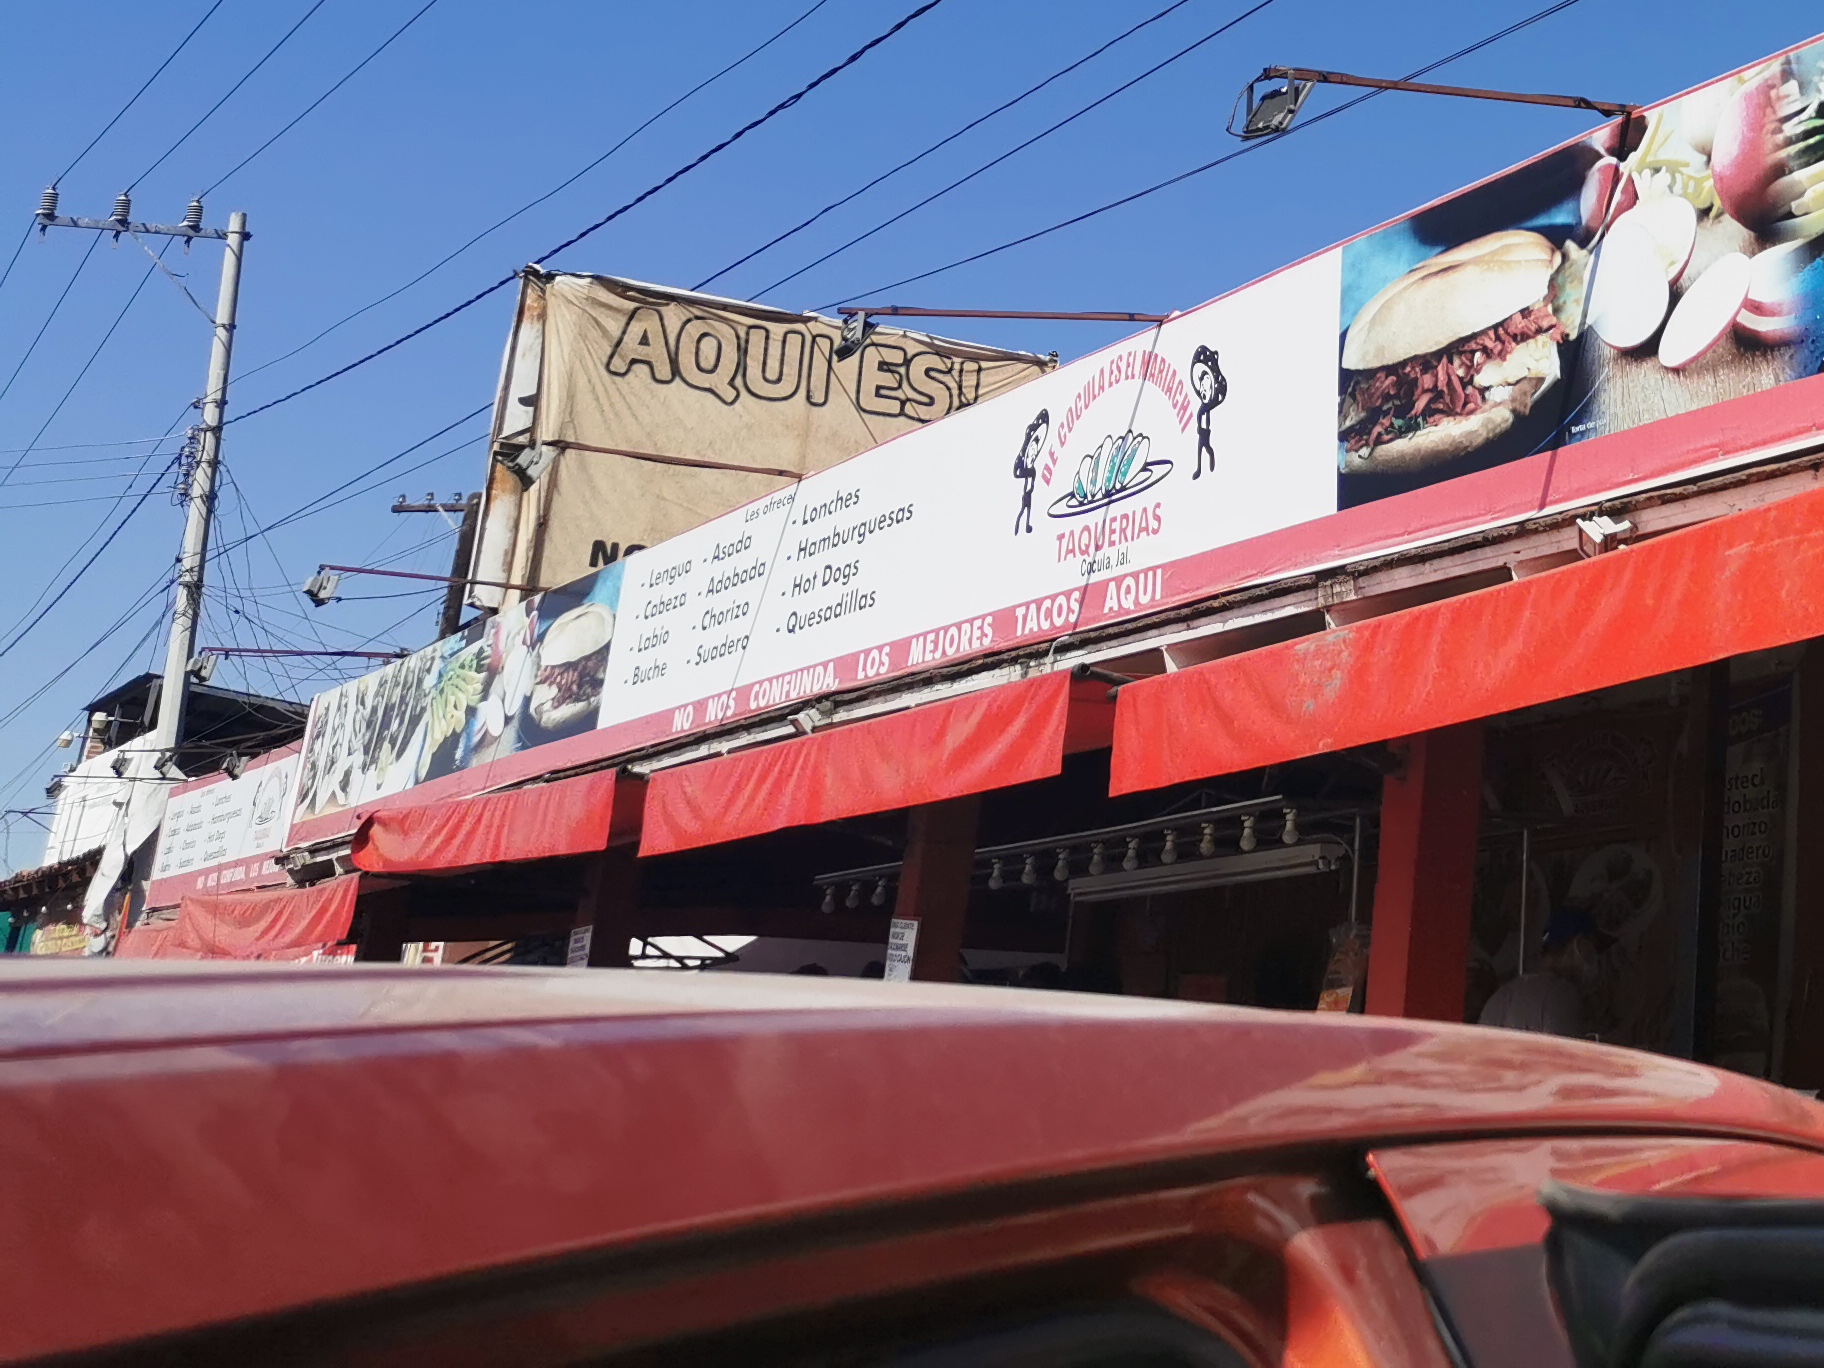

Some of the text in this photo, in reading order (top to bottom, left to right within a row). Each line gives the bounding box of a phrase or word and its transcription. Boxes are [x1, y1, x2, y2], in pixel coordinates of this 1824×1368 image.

[606, 306, 834, 407] AQUI
[1040, 349, 1194, 487] DE COCULA ES EL MARIACHI
[802, 488, 860, 527] Lonches
[711, 533, 752, 564] Asada
[797, 502, 914, 562] Hamburguesas
[1055, 501, 1162, 564] TAQUERIAS
[649, 558, 693, 589] Lengua
[1115, 545, 1132, 568] Jal.
[705, 559, 767, 599] Adobada
[791, 558, 859, 600] Hot Dogs
[643, 591, 687, 621] Cabeza
[701, 598, 750, 632] Chorizo
[786, 588, 877, 635] Quesadillas
[637, 625, 670, 655] Labio
[672, 566, 1164, 733] NO NOS CONFUNDA, LOS MEJORES TACOS AQUI
[695, 633, 749, 667] Suadero
[632, 657, 668, 686] Buche
